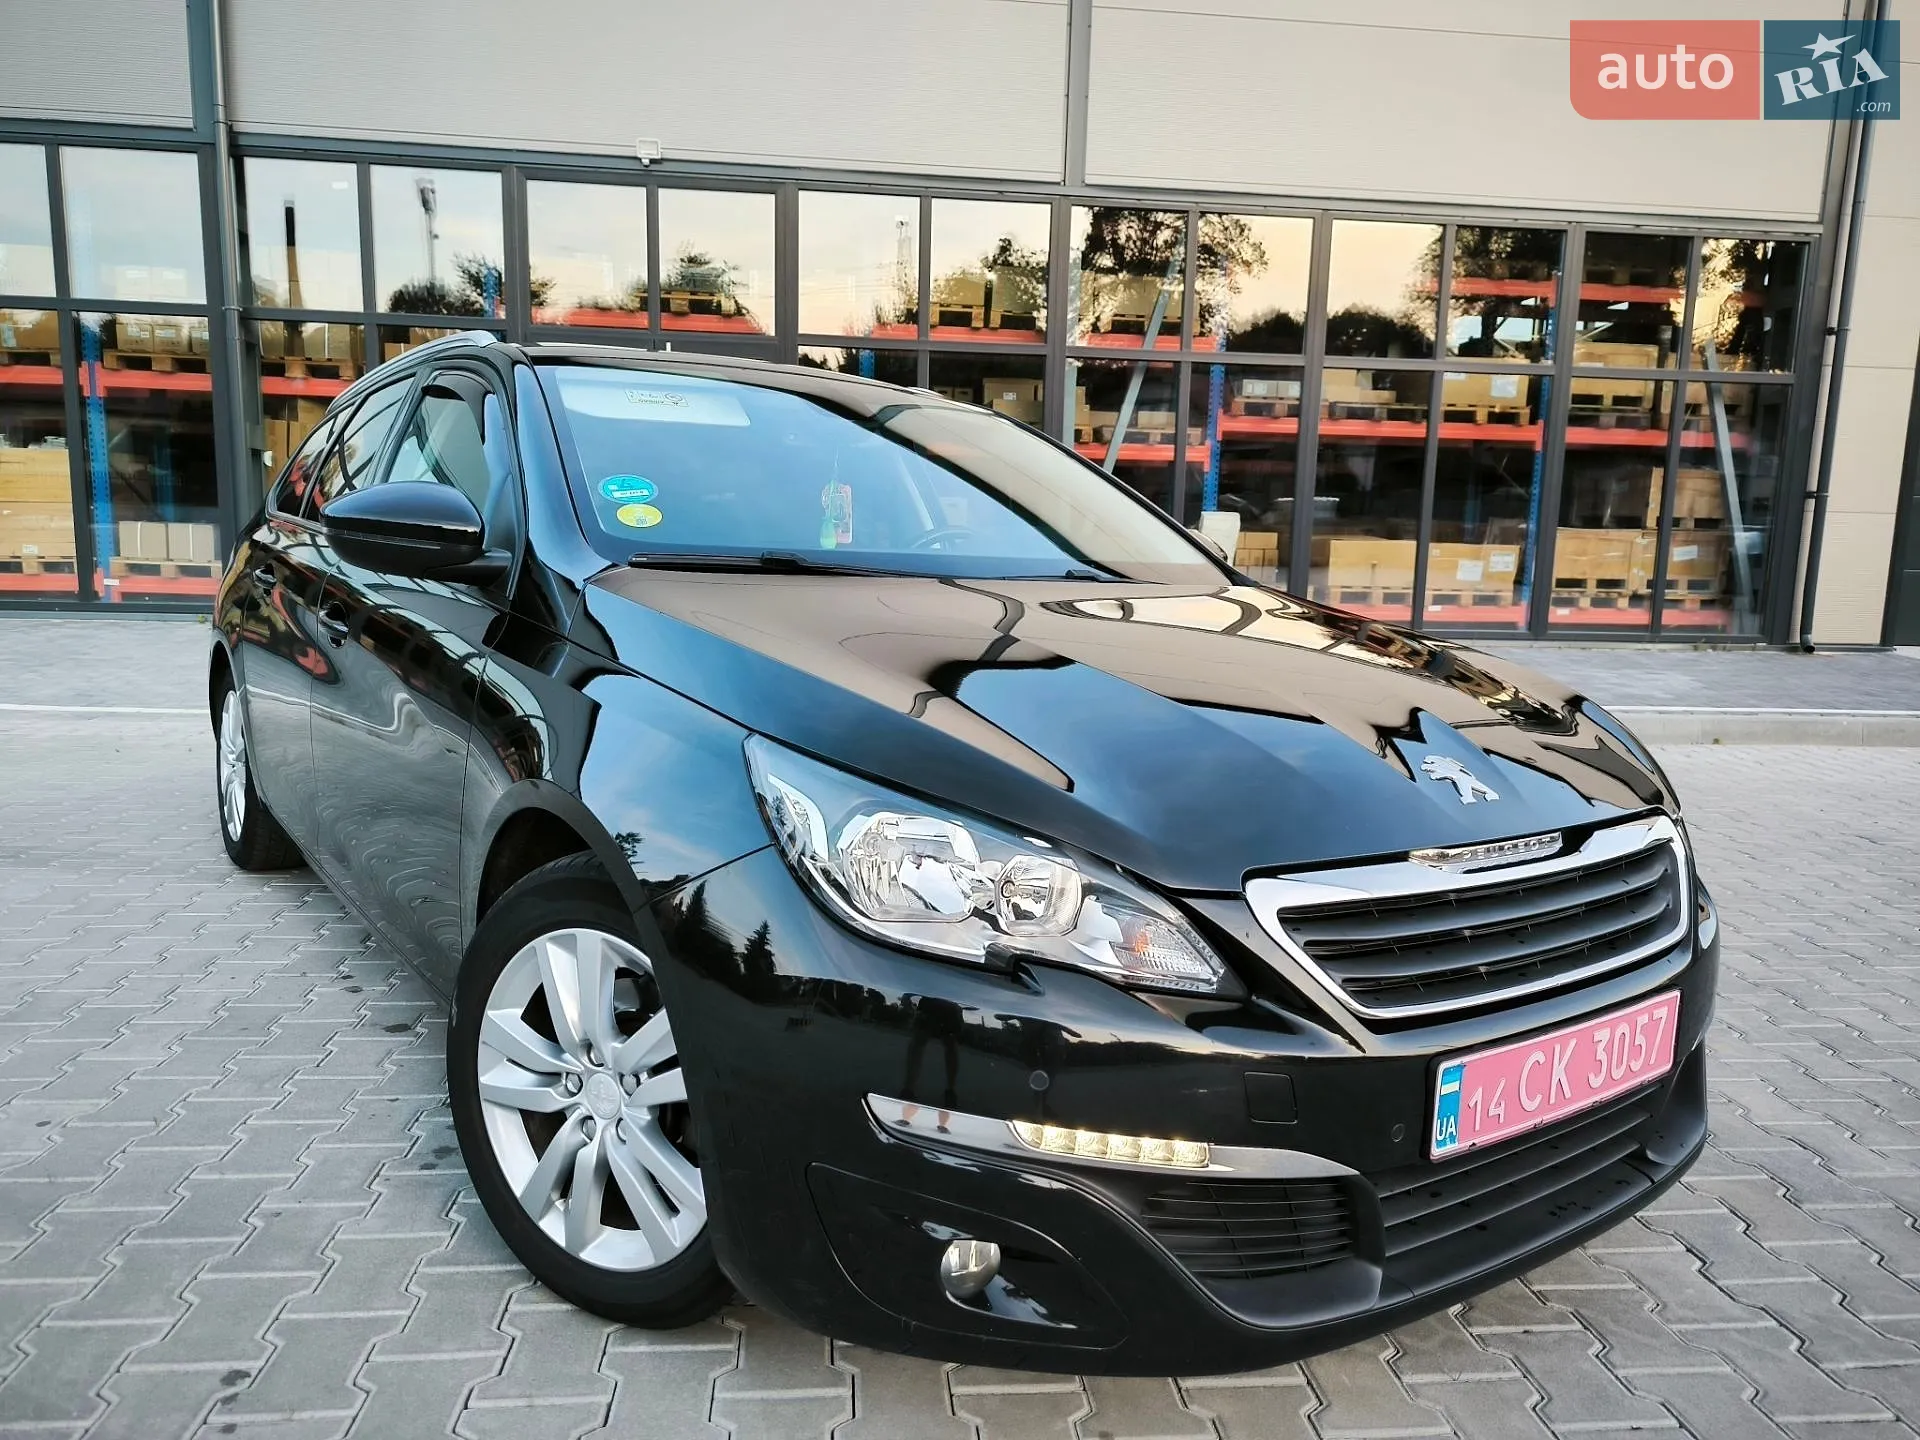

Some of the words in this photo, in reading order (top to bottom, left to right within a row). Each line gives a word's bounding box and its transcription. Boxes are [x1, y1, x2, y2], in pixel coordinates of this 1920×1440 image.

[1461, 837, 1552, 862] PEUGEOT
[1467, 1077, 1506, 1132] 14
[1519, 1037, 1577, 1112] CK
[1587, 1006, 1668, 1089] 3057
[1436, 1116, 1457, 1141] UA
